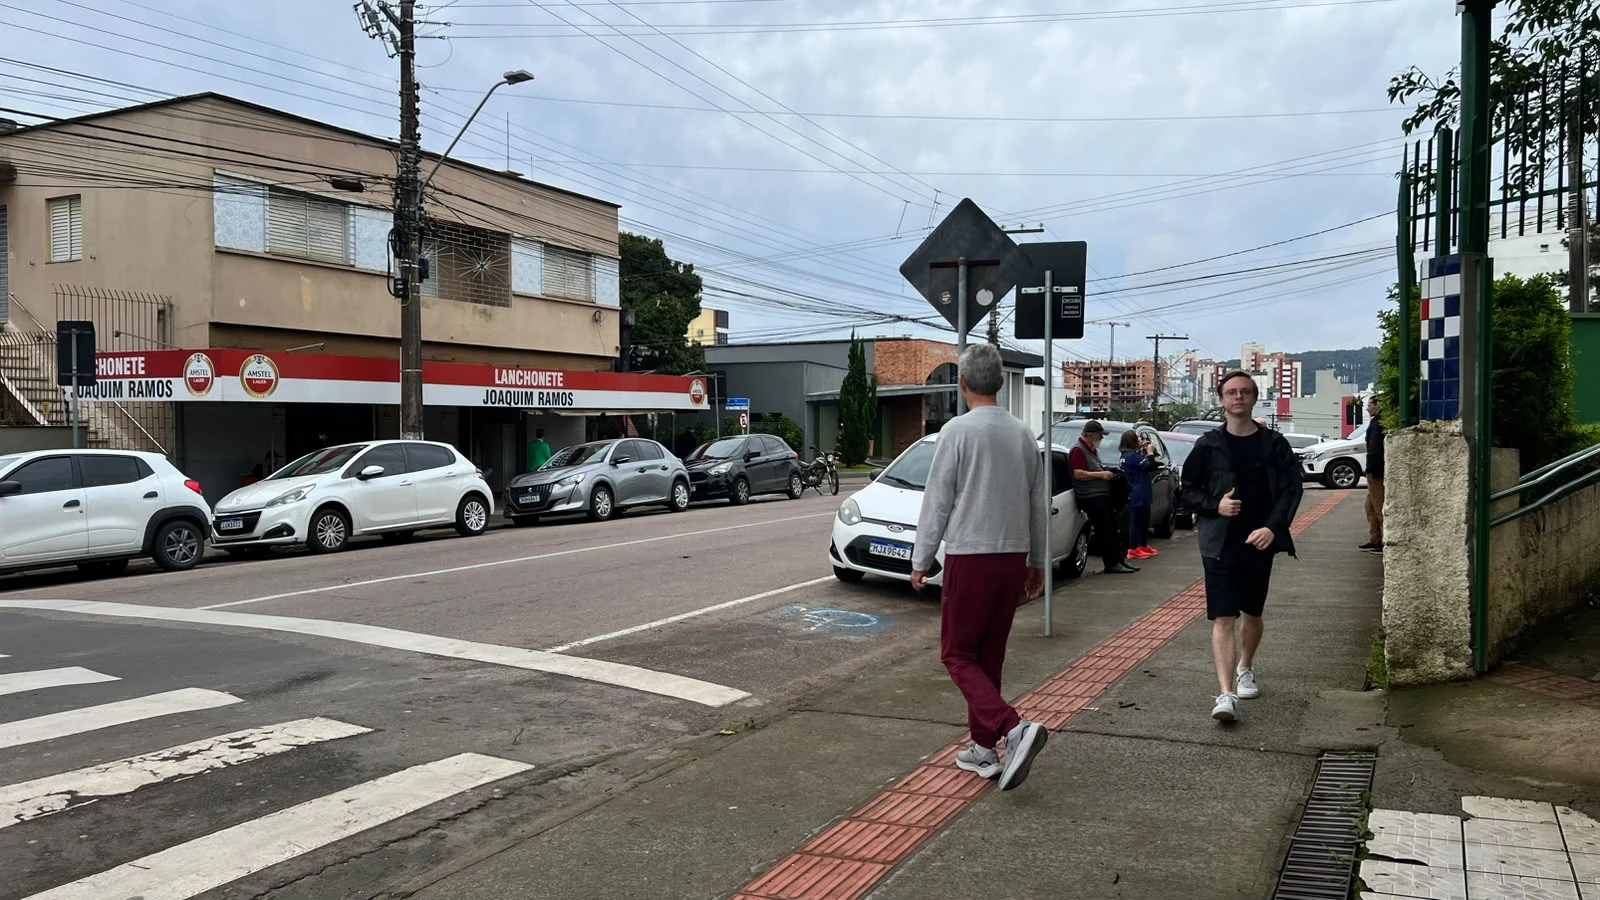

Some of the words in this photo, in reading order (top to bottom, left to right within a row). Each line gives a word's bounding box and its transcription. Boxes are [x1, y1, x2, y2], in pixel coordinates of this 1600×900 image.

[96, 356, 146, 376] HONETE
[190, 368, 209, 376] AMSTEL
[247, 369, 272, 378] AMSTEL
[494, 368, 564, 387] LANCHONETE
[128, 379, 173, 398] RAMOS
[482, 389, 534, 407] JOAQUIM
[538, 391, 574, 406] RAMOS
[872, 544, 907, 558] MJX9G42
